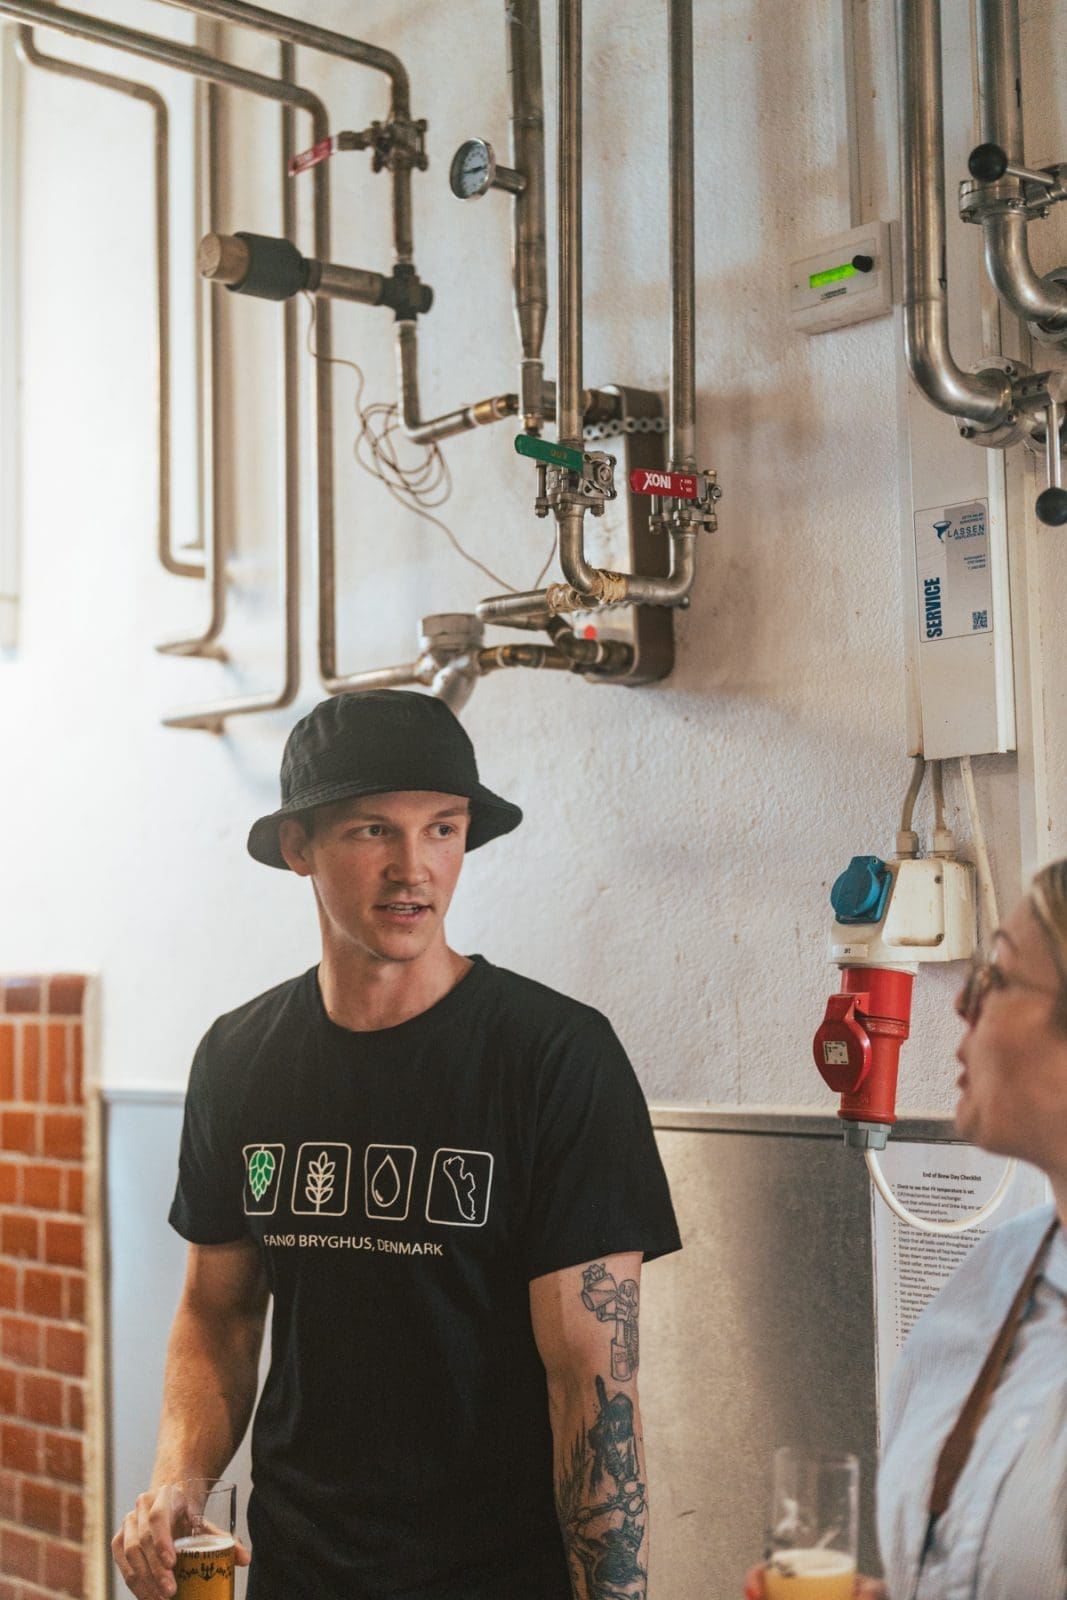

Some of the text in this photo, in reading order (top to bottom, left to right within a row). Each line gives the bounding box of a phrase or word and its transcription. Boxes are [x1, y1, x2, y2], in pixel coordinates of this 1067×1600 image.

[643, 471, 672, 490] INOX
[948, 524, 985, 538] LASSEN
[924, 577, 942, 638] SERVICE
[264, 1234, 444, 1256] FANØ BRYGHUS, DENMARK
